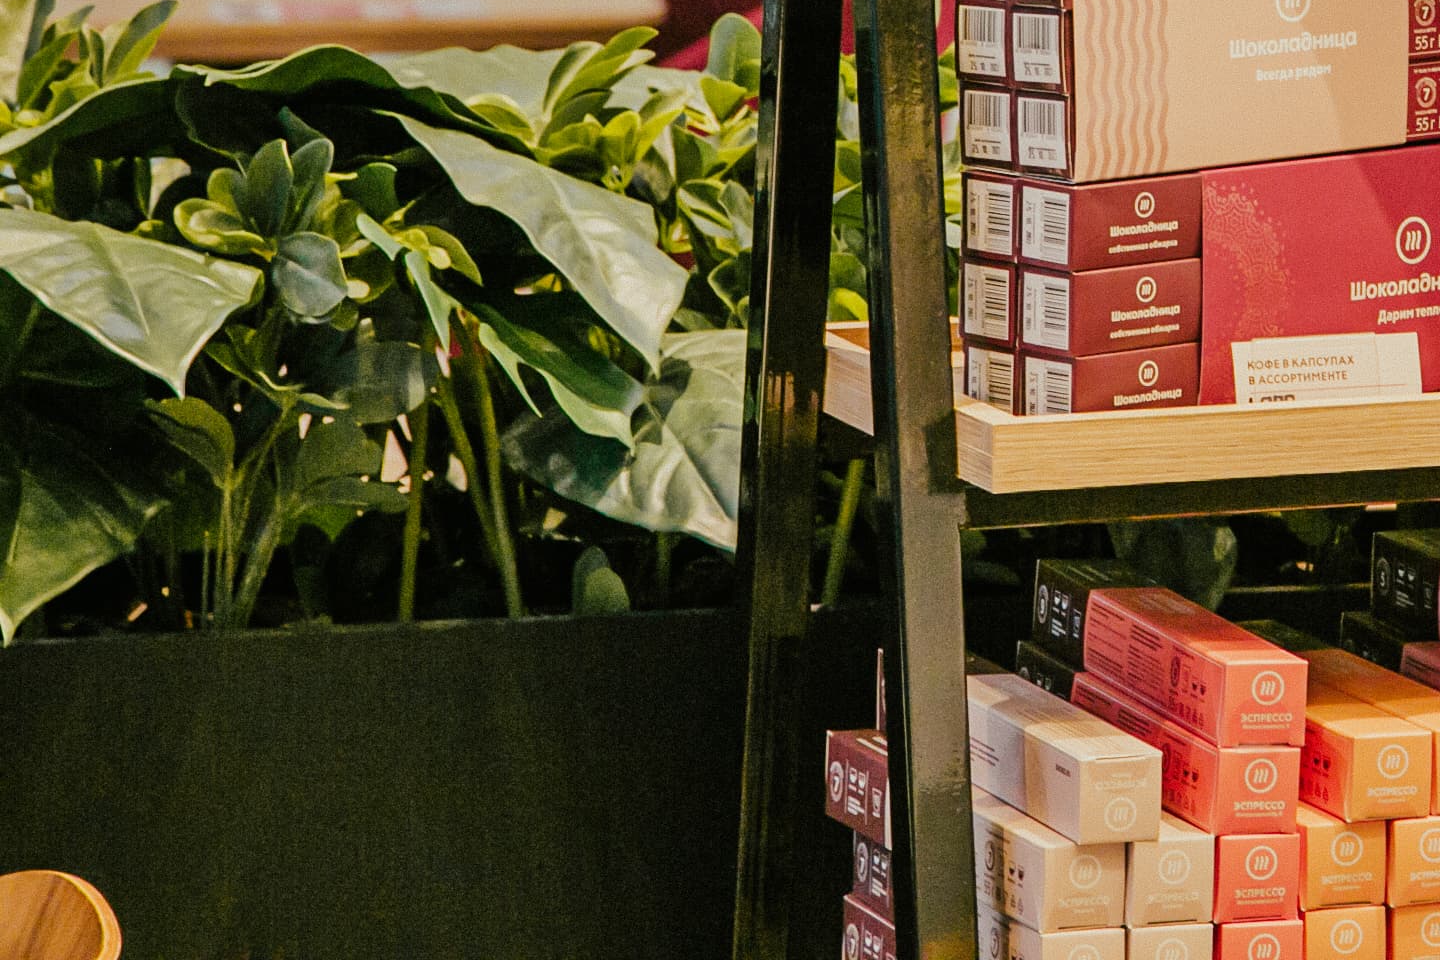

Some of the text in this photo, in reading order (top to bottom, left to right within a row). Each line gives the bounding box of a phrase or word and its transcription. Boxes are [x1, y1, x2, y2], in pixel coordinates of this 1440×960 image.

[1229, 31, 1357, 59] Шоколадница
[1109, 221, 1179, 238] Шоколадница
[1111, 305, 1180, 322] Шоколадница
[1247, 355, 1355, 370] КОФЕ В КАПСУЛАХ
[1248, 370, 1348, 385] В АССОРТИМЕНТЕ
[1113, 388, 1182, 406] Шоколадница
[1241, 713, 1293, 723] ЭСПРЕССО
[1233, 800, 1286, 810] ЭСПРЕССО
[1234, 886, 1286, 898] ЭСПРЕССО
